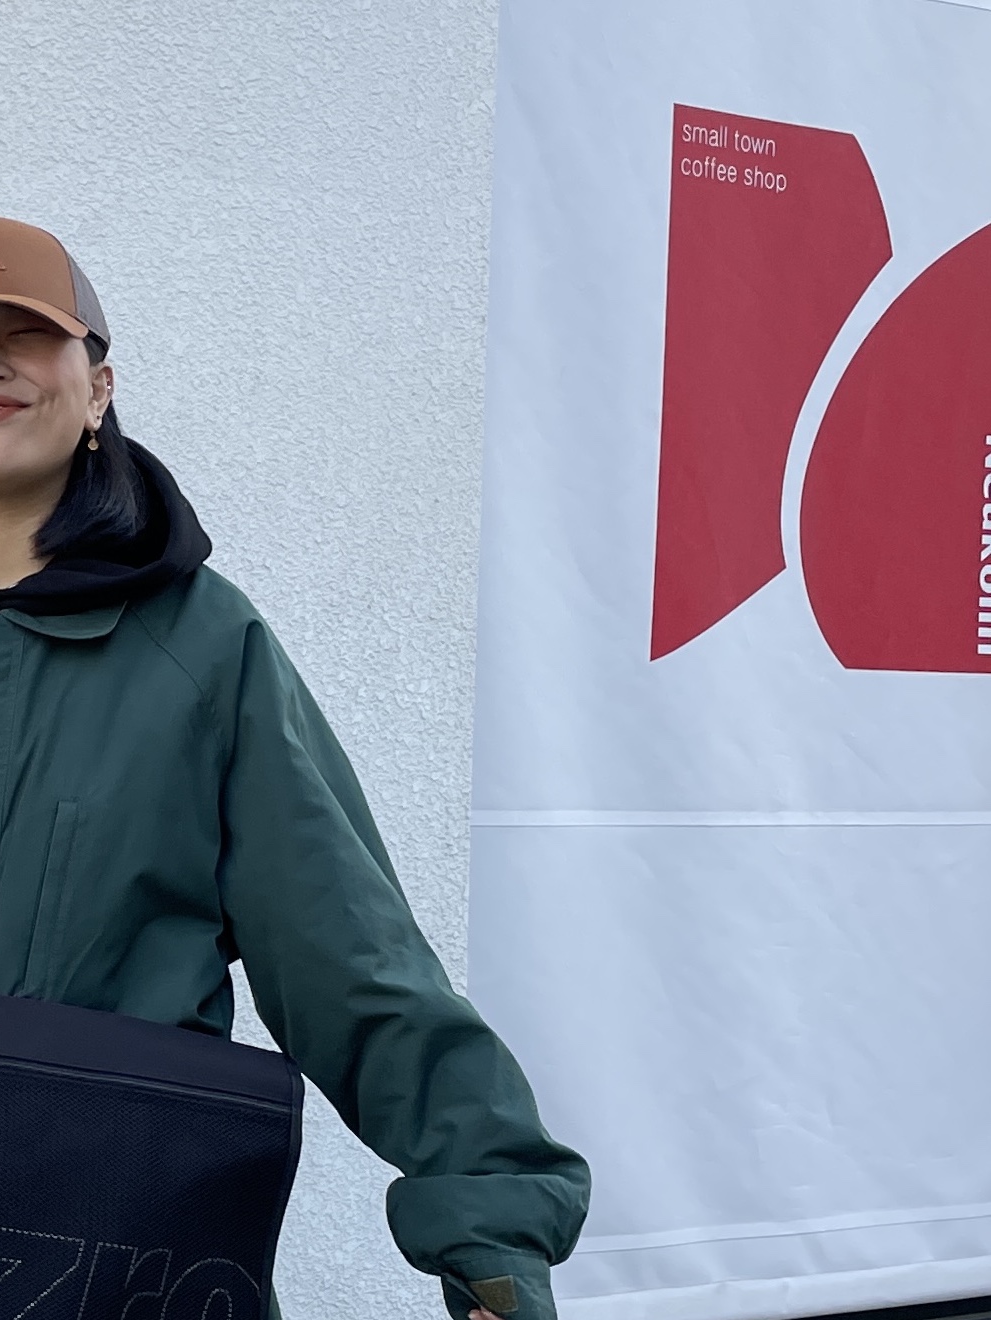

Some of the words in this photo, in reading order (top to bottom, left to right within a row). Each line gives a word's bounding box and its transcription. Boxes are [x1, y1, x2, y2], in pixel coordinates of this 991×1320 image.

[681, 123, 728, 149] small
[734, 130, 776, 158] town
[680, 155, 738, 183] coffee
[743, 165, 788, 194] shop
